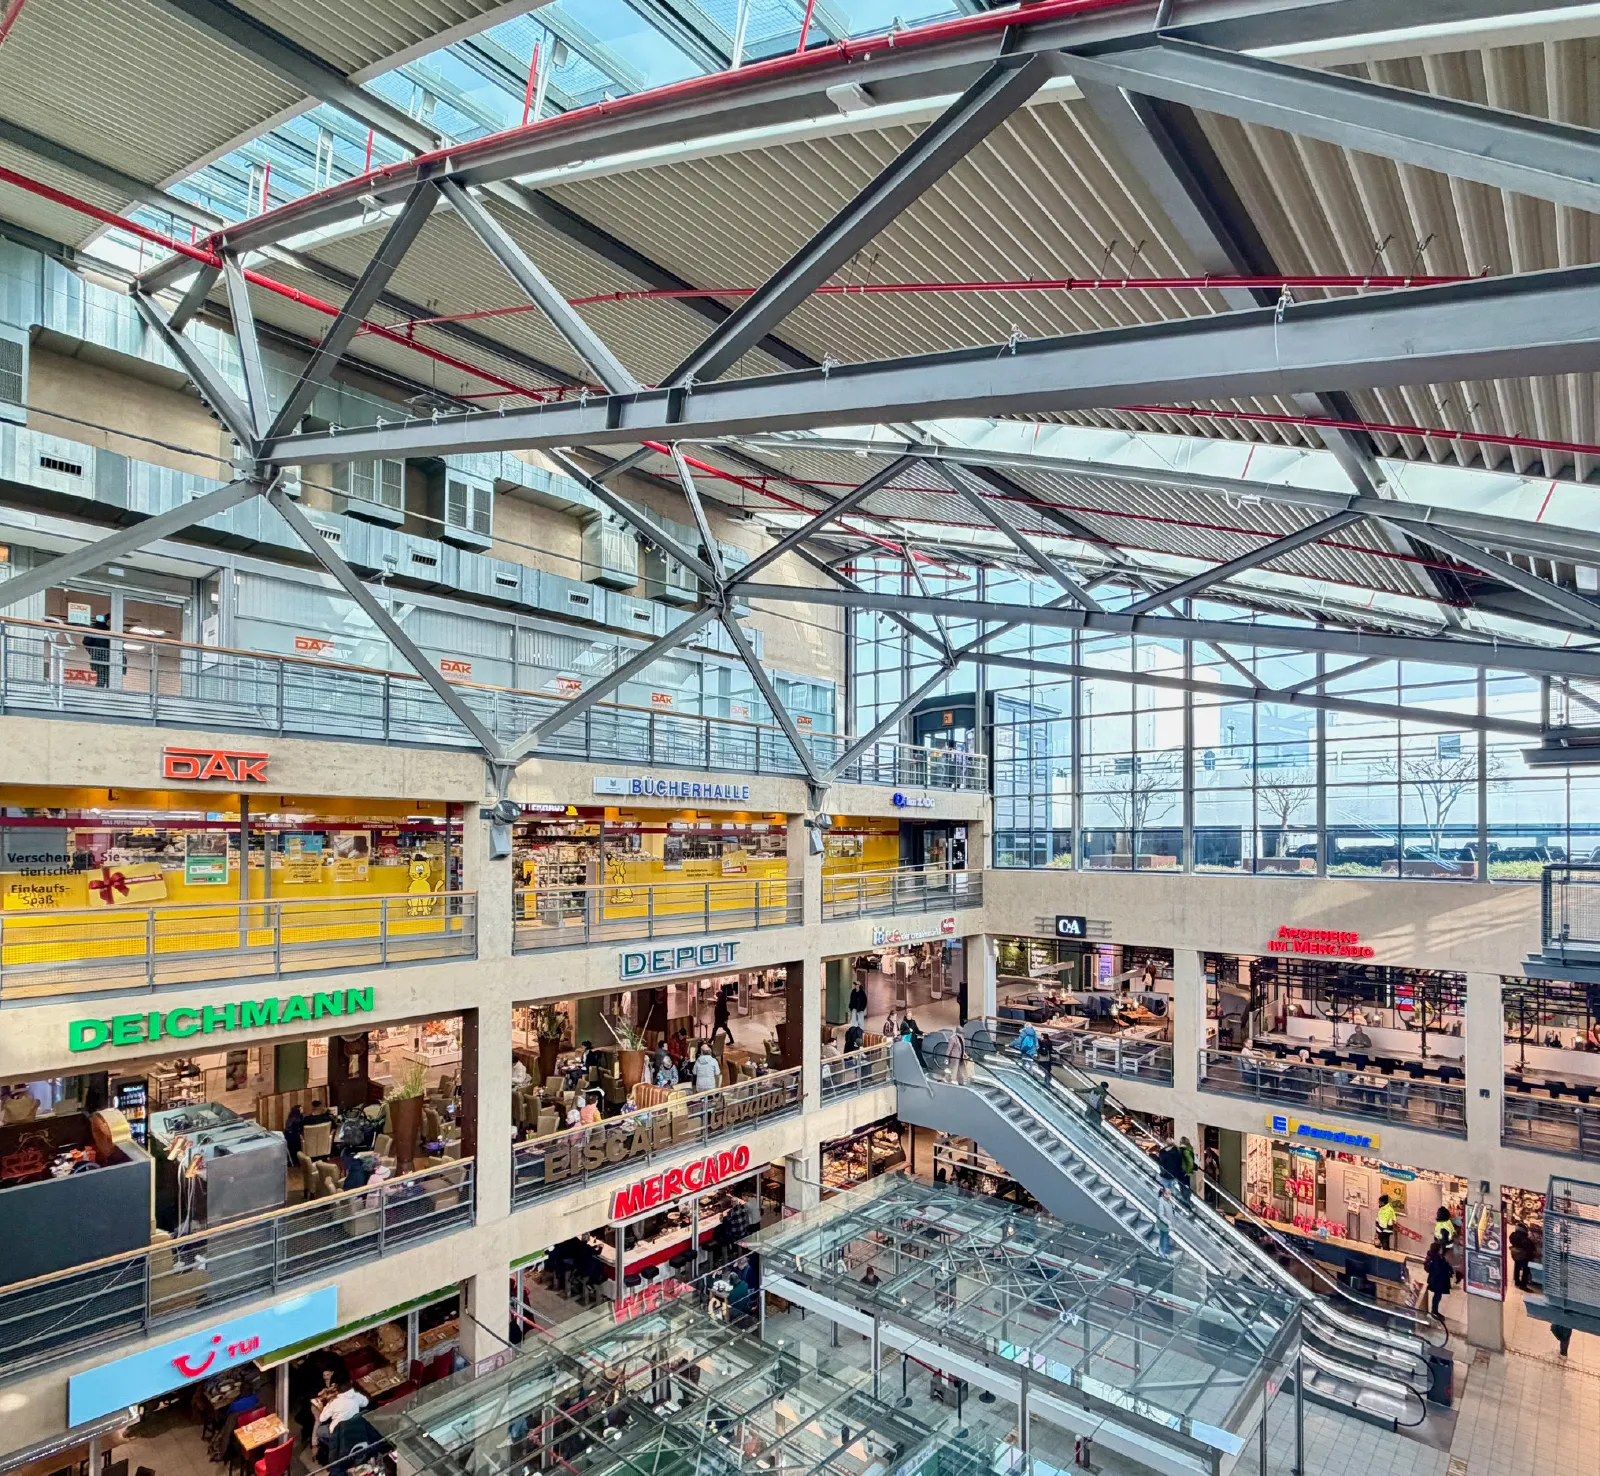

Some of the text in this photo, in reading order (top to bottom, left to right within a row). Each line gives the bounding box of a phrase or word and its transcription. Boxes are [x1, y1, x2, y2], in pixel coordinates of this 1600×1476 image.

[440, 659, 471, 674] DAK
[651, 693, 672, 704] DAK
[797, 716, 812, 725] DAK
[163, 746, 270, 782] DAK
[632, 776, 749, 799] BÜCHERHALLE
[7, 851, 120, 863] Verschenken Sie
[20, 866, 82, 877] tierischen
[11, 883, 71, 894] Einkaufs-
[23, 894, 55, 905] Spaß
[1277, 925, 1360, 944] APOTHEKE
[622, 941, 741, 976] DEPOT
[1267, 940, 1375, 959] IM MERCADO
[69, 986, 375, 1052] DEICHMANN
[612, 1144, 750, 1220] MERCADO
[226, 1336, 260, 1359] TUI
